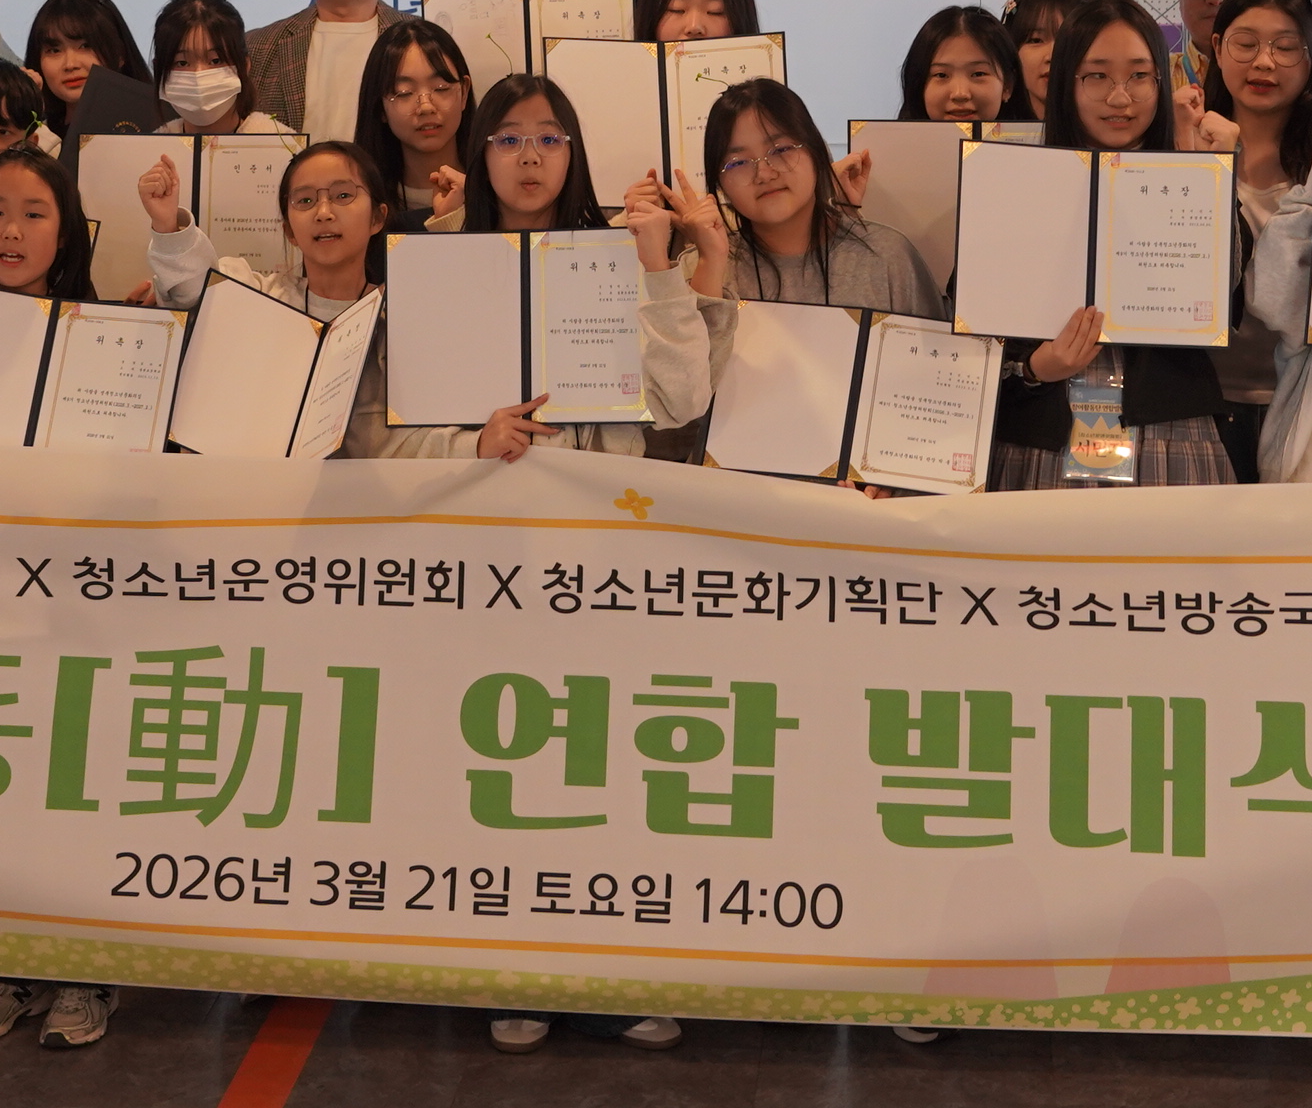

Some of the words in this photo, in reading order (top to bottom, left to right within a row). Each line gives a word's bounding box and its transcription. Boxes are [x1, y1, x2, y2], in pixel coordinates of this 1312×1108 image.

[16, 558, 54, 599] X
[72, 555, 466, 609] 청소년운영위원회
[485, 565, 524, 609] X
[541, 561, 943, 627] 청소년문화기획단
[960, 586, 999, 626] X
[459, 671, 800, 841] 연합
[110, 851, 292, 906] 2026년
[310, 859, 387, 913] 3월
[404, 863, 512, 919] 21일
[529, 868, 674, 927] 토요일
[694, 878, 844, 931] 14:00
